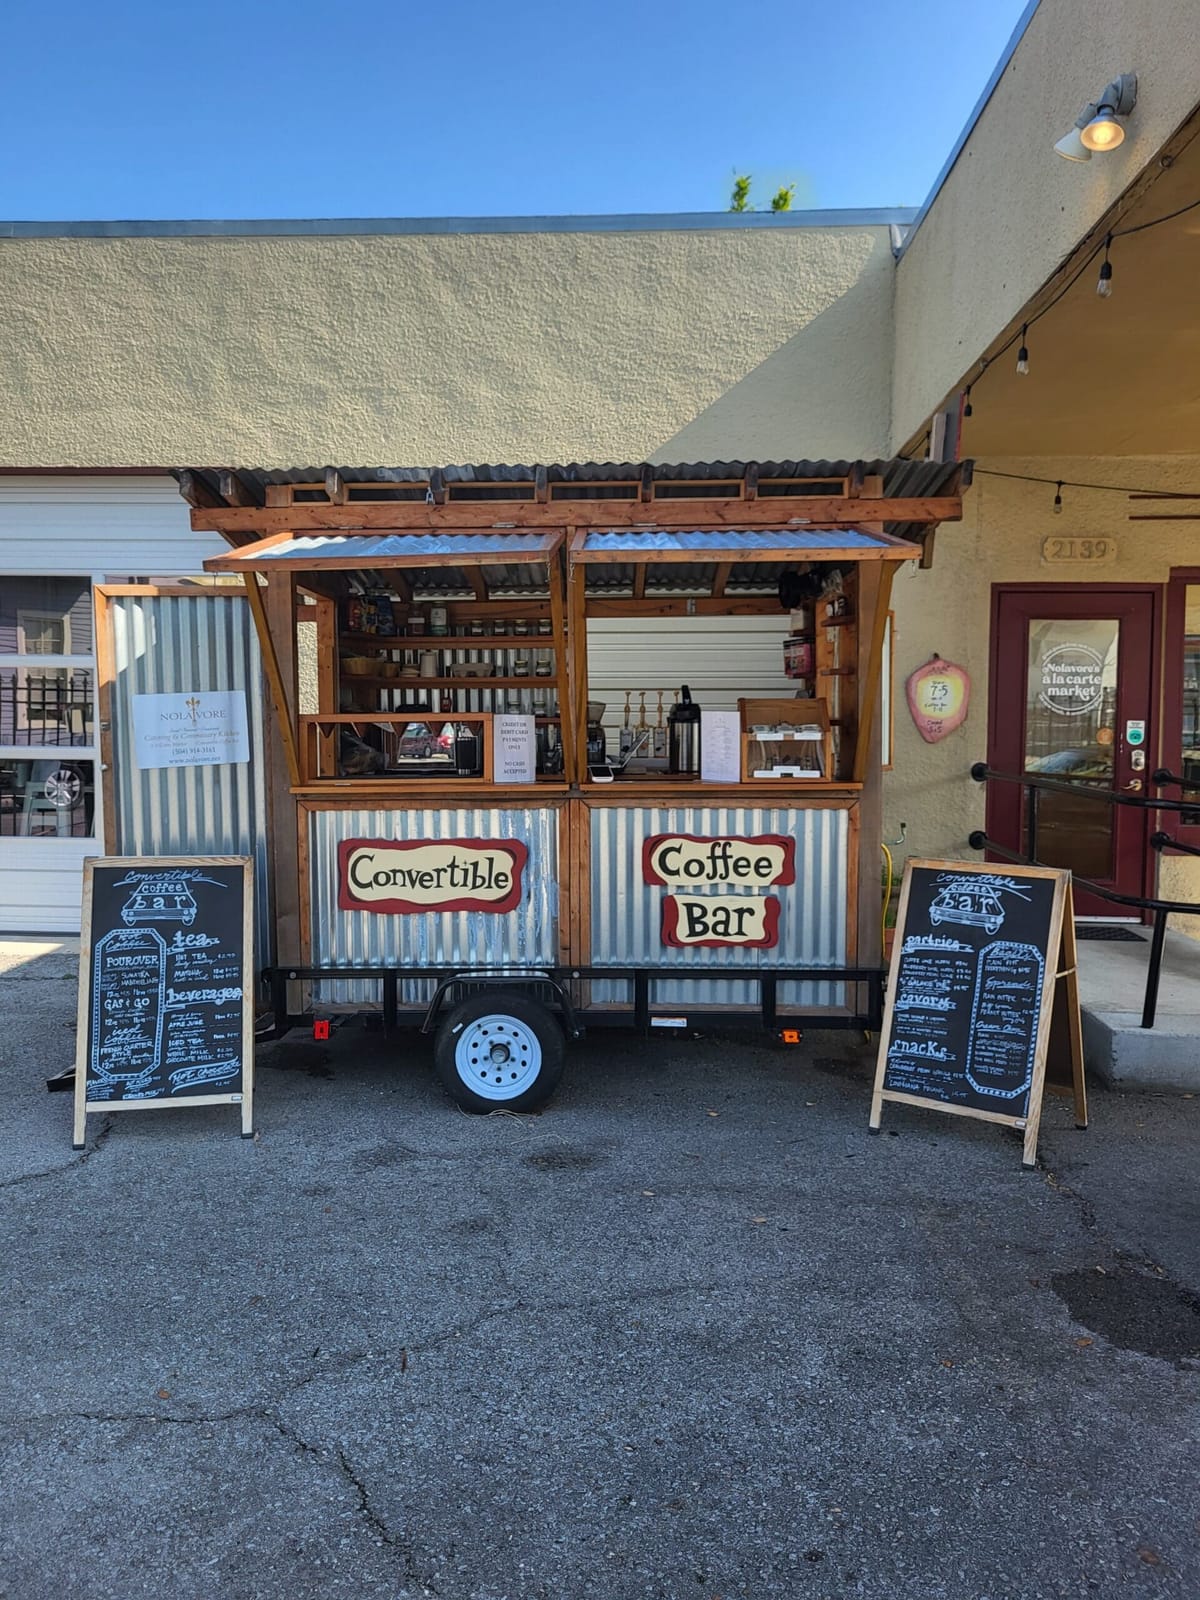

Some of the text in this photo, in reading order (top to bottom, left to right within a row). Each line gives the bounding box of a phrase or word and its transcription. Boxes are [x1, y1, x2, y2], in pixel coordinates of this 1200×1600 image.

[1051, 540, 1107, 560] 2139
[1066, 674, 1101, 685] carte
[1047, 685, 1097, 701] market
[657, 842, 773, 878] Coffee
[124, 869, 206, 882] Convertible
[350, 854, 509, 890] Convertible
[141, 883, 184, 893] coffee
[943, 894, 995, 914] bar
[681, 902, 755, 938] Bar
[173, 930, 208, 947] tea
[906, 933, 960, 948] pastries
[191, 952, 207, 960] TEA
[166, 987, 243, 1005] beverages
[104, 999, 124, 1011] GAS
[134, 998, 150, 1009] GO
